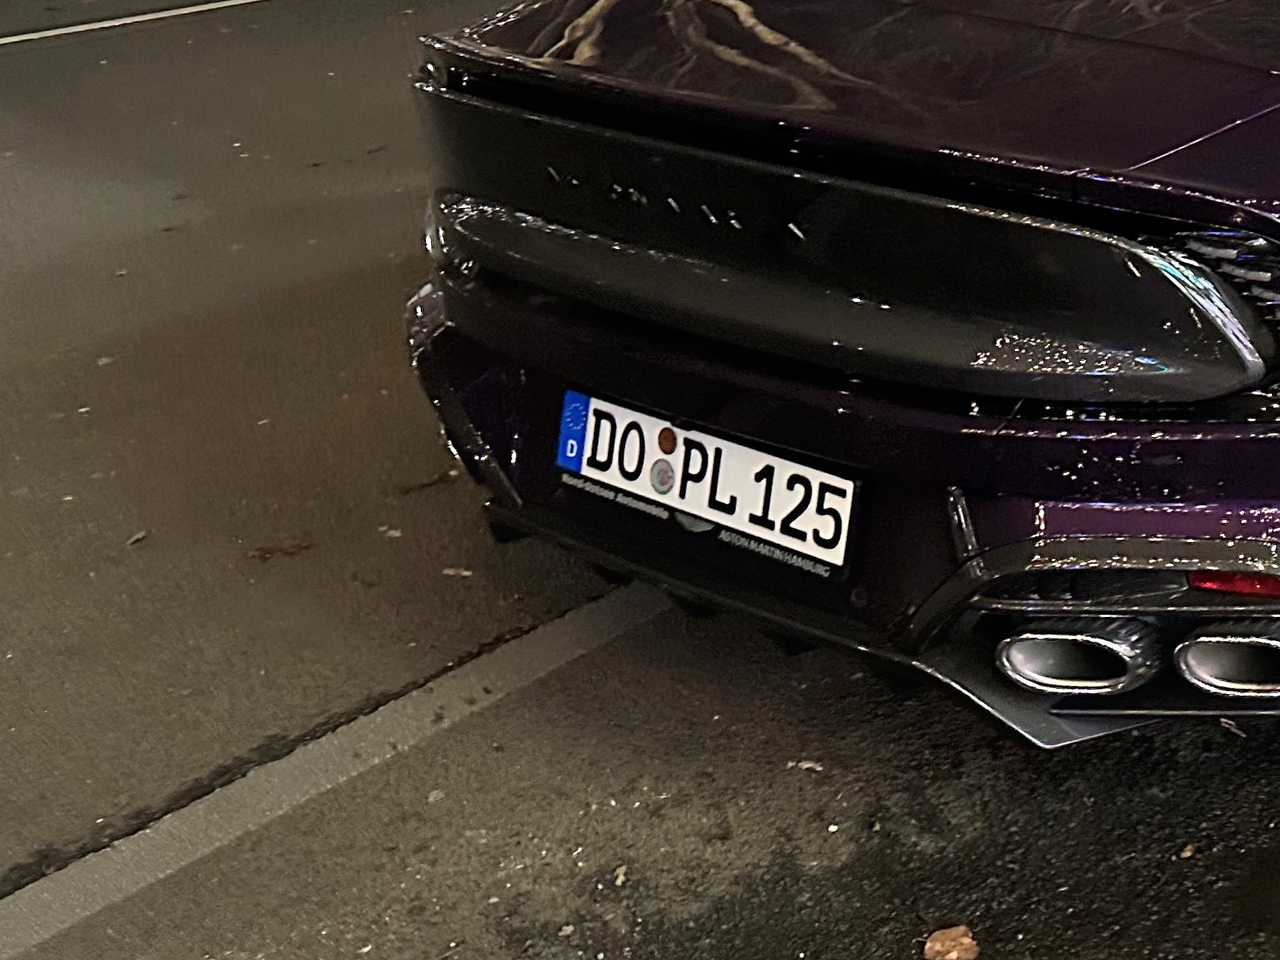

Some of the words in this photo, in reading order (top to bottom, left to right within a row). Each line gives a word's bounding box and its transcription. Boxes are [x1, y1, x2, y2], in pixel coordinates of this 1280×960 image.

[566, 439, 577, 458] D
[586, 407, 646, 482] DO
[678, 436, 738, 516] PL
[748, 463, 848, 550] 125
